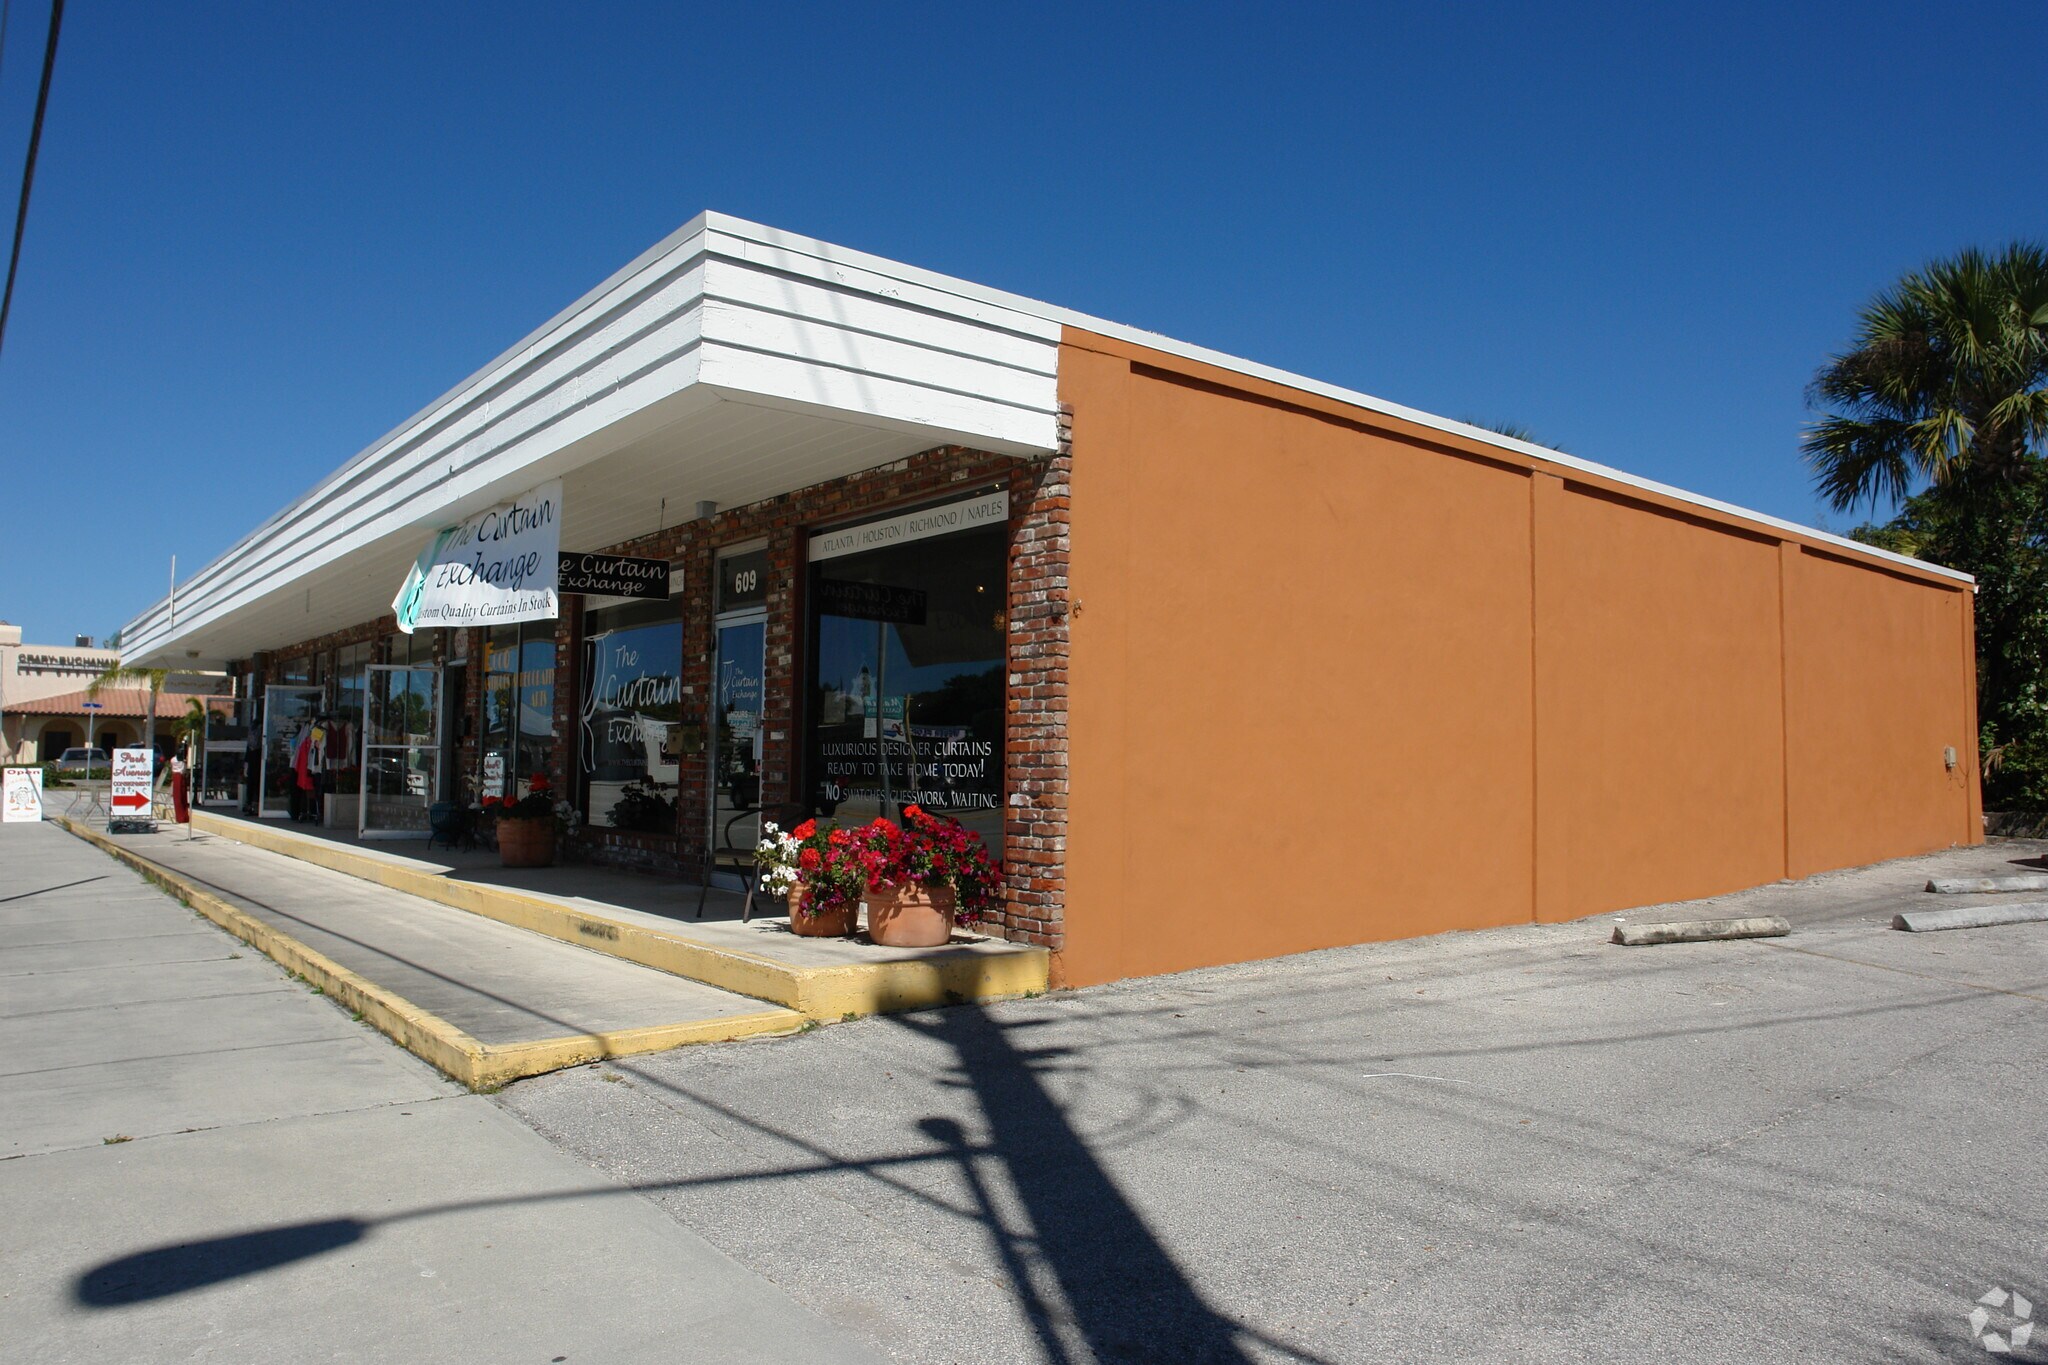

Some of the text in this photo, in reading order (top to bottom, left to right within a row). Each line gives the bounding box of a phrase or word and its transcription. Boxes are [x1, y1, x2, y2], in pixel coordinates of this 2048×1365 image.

[444, 499, 555, 552] The Curtain
[822, 536, 854, 552] ATLANTA
[862, 525, 900, 544] HOUSTON
[909, 511, 957, 533] RICHMOND
[967, 501, 1003, 521] NAPLES
[436, 550, 542, 592] Exchange
[581, 554, 666, 580] Curtain
[558, 572, 645, 594] Exchange
[735, 570, 757, 593] 609
[417, 592, 551, 621] stom Quality Curtains In Stock
[615, 645, 639, 668] The
[605, 670, 681, 708] Curtain
[731, 676, 758, 688] Curtain
[607, 715, 668, 753] Exchang
[120, 752, 146, 763] Park
[823, 742, 991, 756] LUXURIOUS DESIGNER CURTAINS
[113, 766, 151, 777] Avenue
[827, 758, 984, 778] READY TO TAKE HOME TODAY!
[825, 785, 839, 800] NO
[951, 790, 998, 809] WAITING
